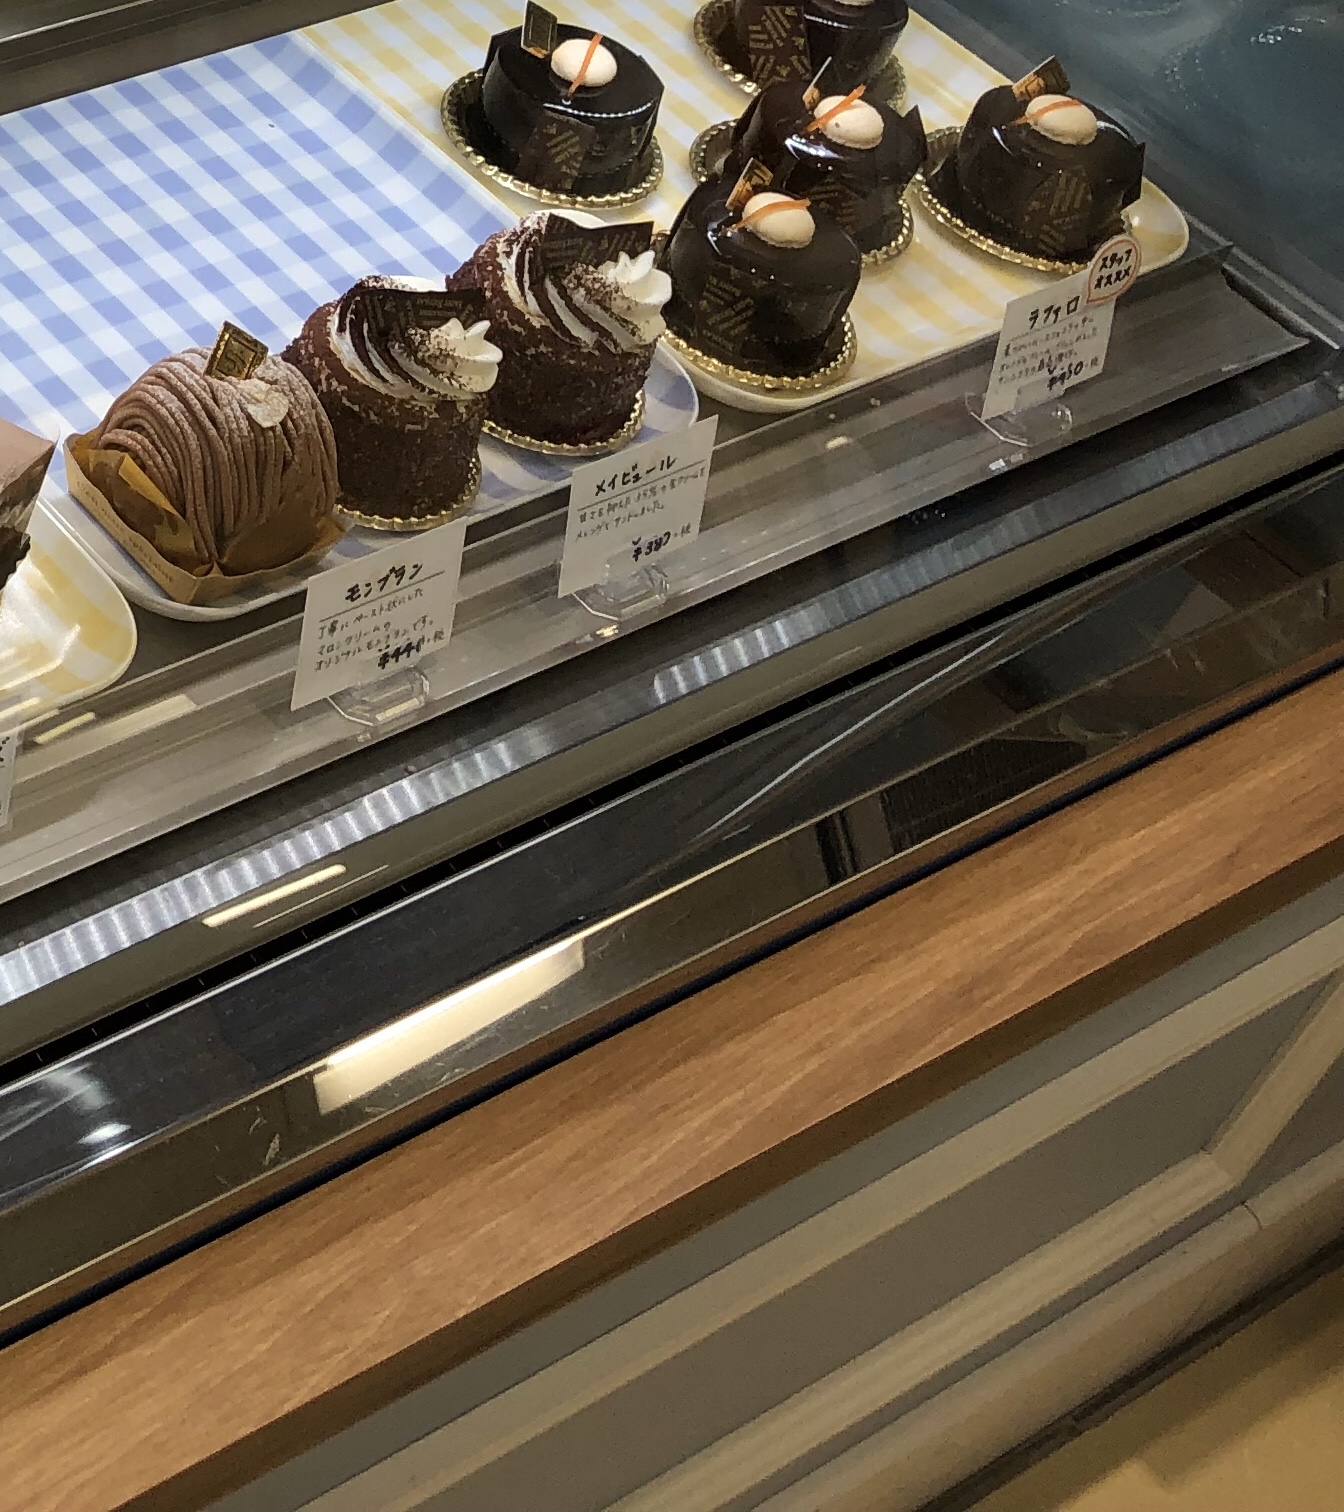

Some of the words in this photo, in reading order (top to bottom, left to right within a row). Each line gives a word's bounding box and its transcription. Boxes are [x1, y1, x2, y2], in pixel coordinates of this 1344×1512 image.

[1094, 265, 1132, 289] オススメ
[1100, 248, 1132, 273] スタッフ
[594, 446, 678, 499] メイビュール
[343, 553, 424, 607] モンブラン
